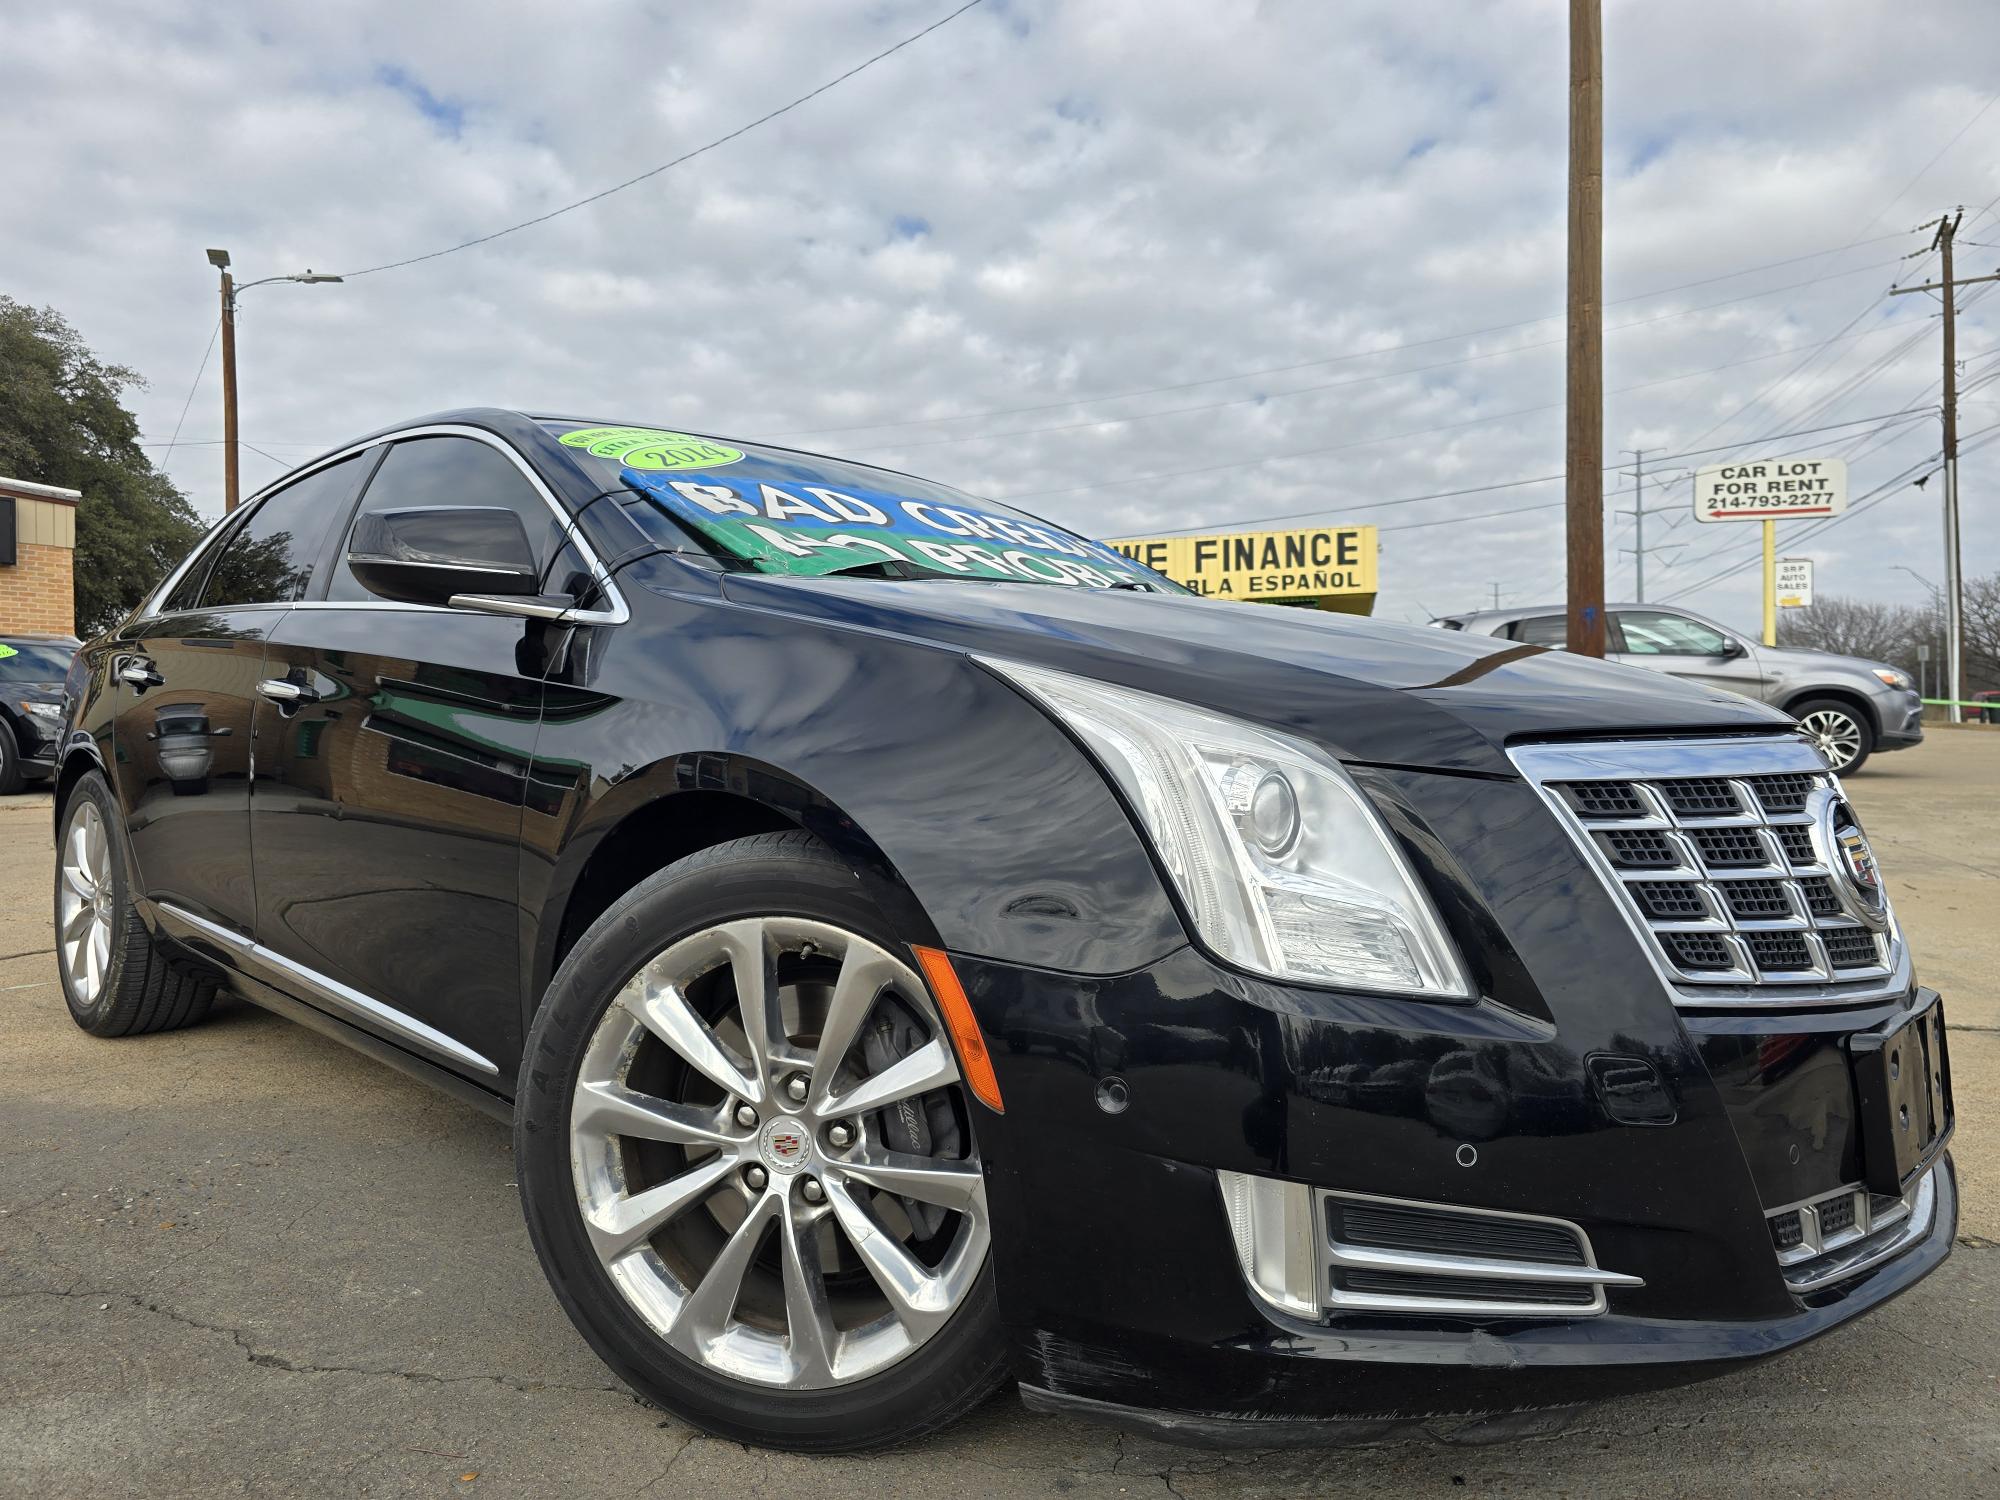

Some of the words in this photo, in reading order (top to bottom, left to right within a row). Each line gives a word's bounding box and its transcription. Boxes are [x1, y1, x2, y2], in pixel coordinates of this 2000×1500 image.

[645, 445, 731, 467] 2014
[1721, 466, 1766, 480] CAR
[1778, 463, 1822, 476] LOT
[1714, 482, 1757, 495] FOR
[1767, 478, 1829, 493] RENT
[1707, 492, 1834, 509] 214-793-2277
[667, 480, 890, 526] BAD
[900, 501, 1138, 573] CREDIT
[1195, 531, 1358, 574] FINANCE
[1249, 571, 1361, 592] ESPAÑOL
